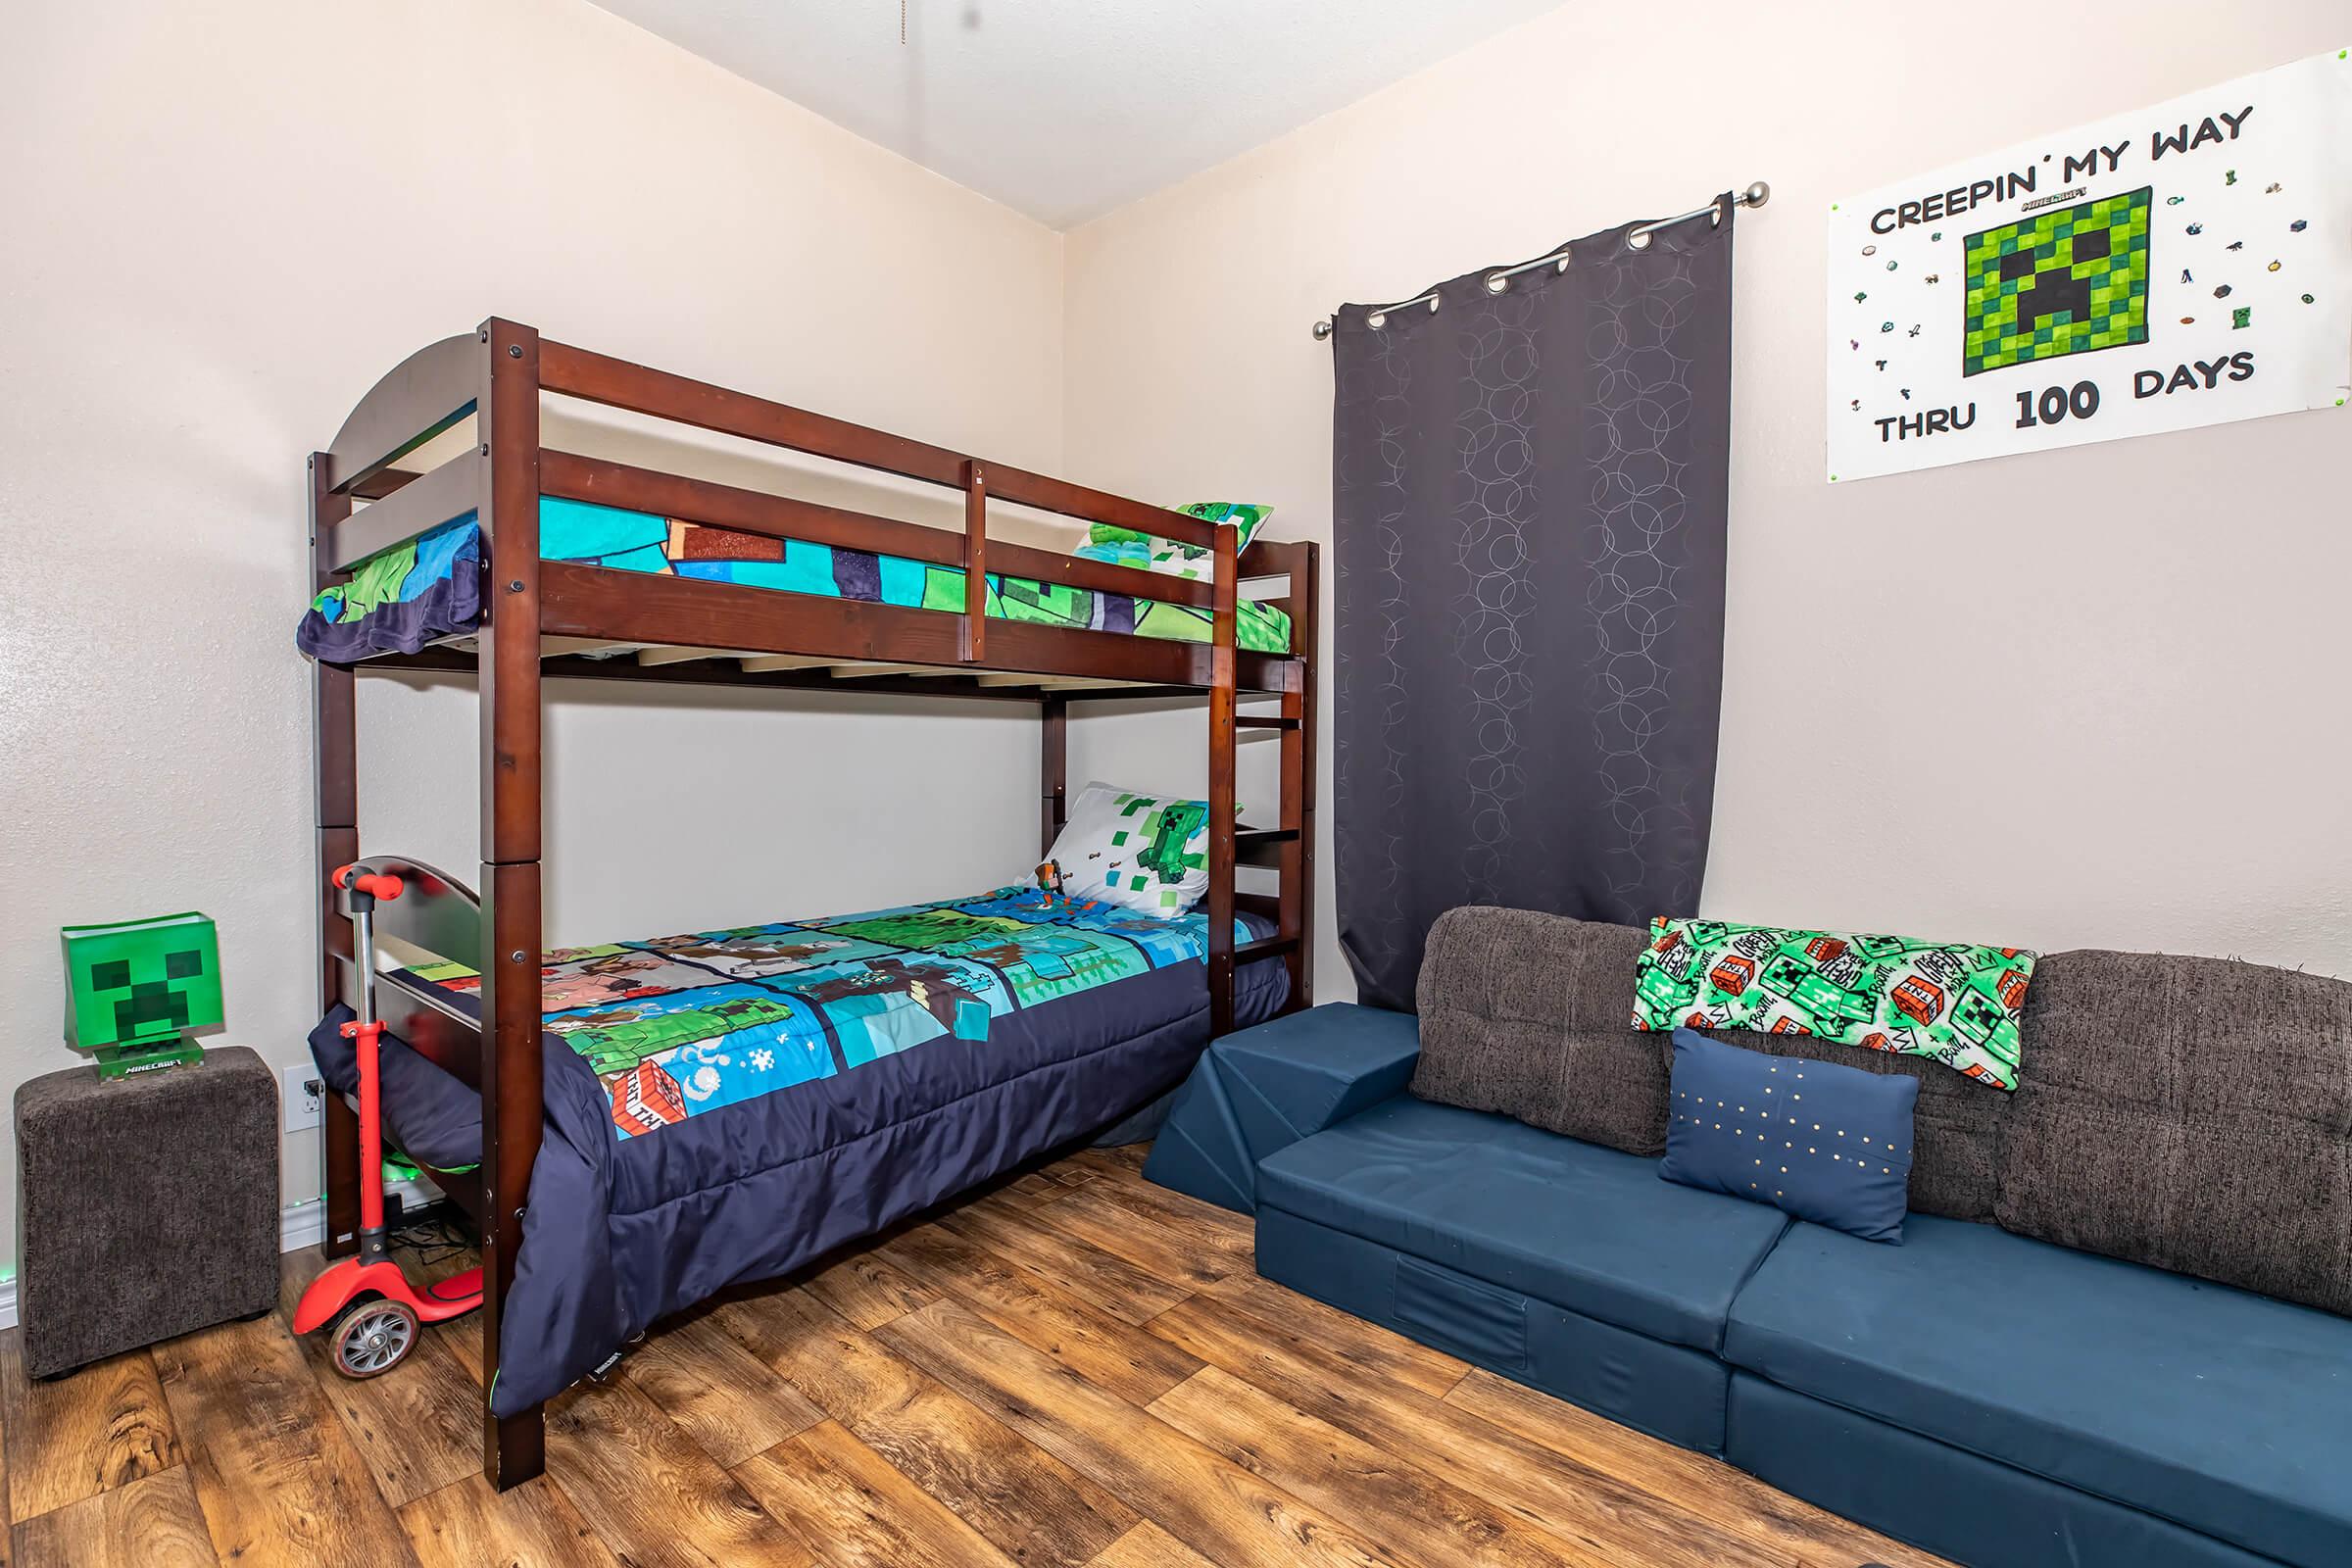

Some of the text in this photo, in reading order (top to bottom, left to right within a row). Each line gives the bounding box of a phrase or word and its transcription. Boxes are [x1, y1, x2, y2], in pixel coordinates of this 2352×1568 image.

[2064, 140, 2131, 183] MY
[2152, 106, 2254, 161] WAY
[1874, 351, 2255, 443] THRU 100 DAYS
[1720, 961, 1741, 973] TNT
[1903, 983, 1929, 1002] TNT
[125, 1058, 182, 1075] MINECRAFT
[626, 1073, 639, 1103] TNT
